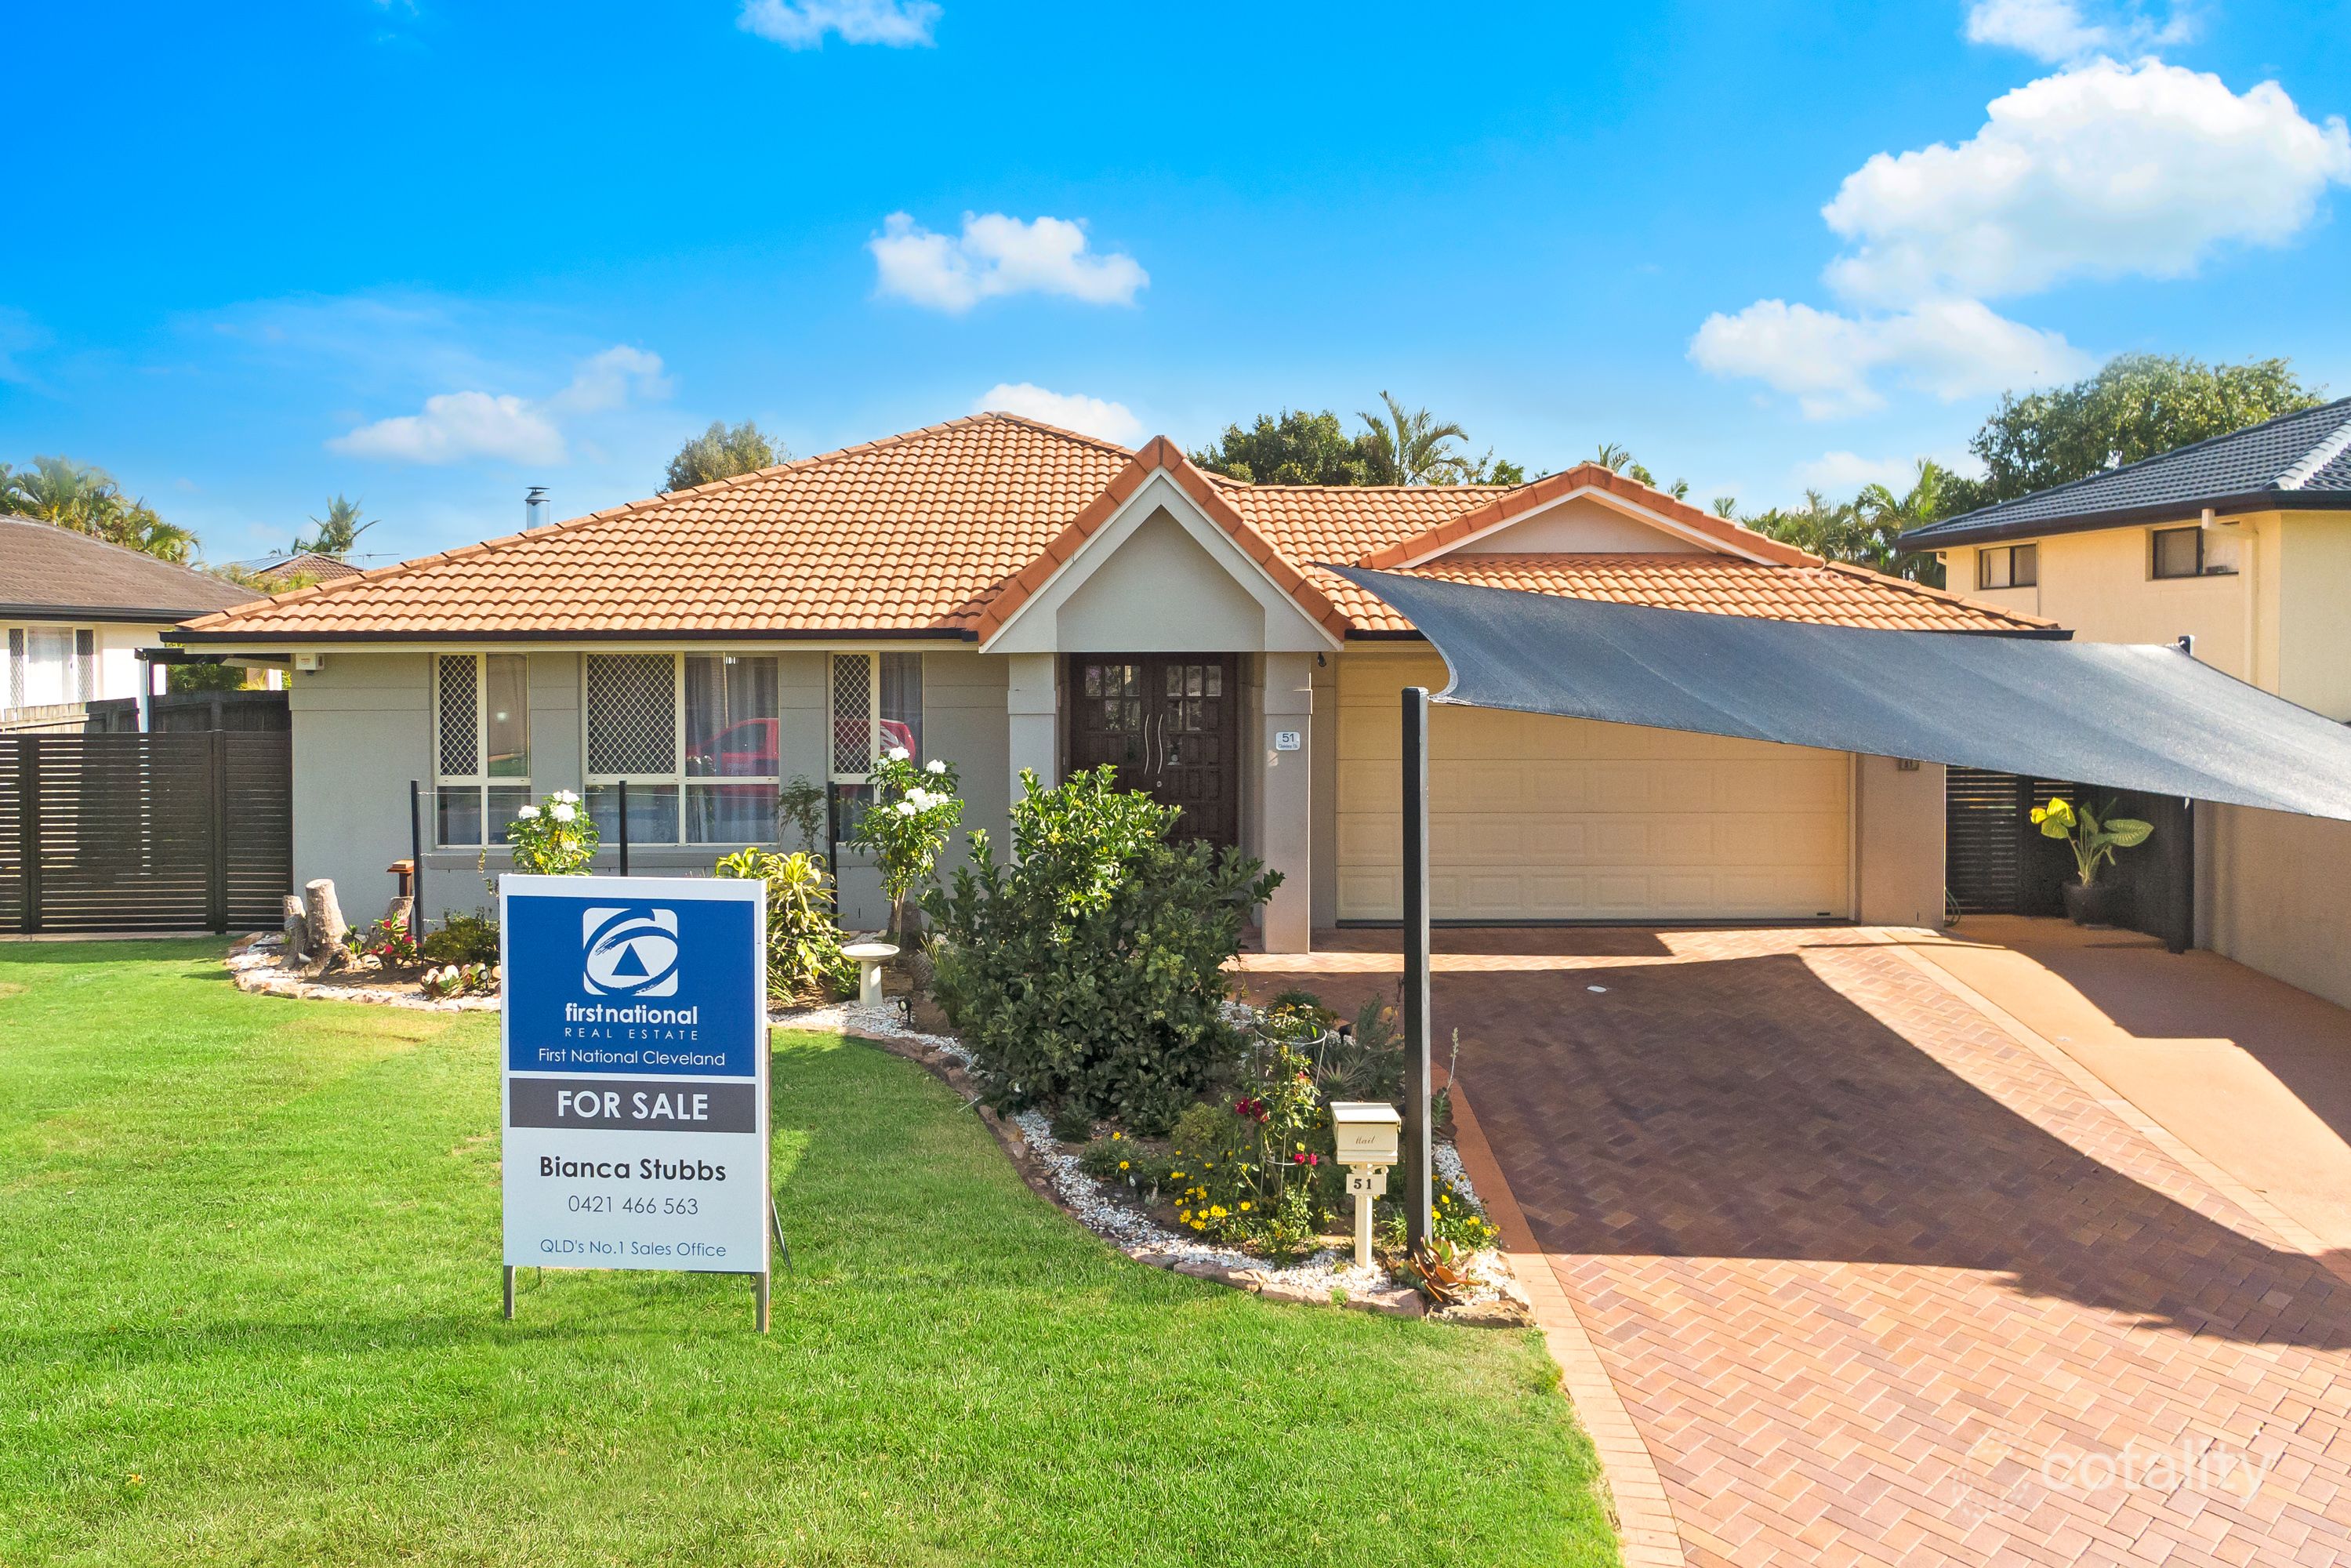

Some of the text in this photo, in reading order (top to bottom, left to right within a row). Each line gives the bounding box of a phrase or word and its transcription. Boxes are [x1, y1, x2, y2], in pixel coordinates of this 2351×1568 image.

[1283, 733, 1294, 742] 51
[565, 1028, 697, 1040] REAL ESTATE
[539, 1048, 724, 1065] First National Cleveland
[558, 1091, 707, 1120] FOR SALE
[541, 1156, 726, 1181] Bianca Stubbs
[1353, 1178, 1372, 1189] 51
[569, 1196, 698, 1214] 0421 466 563
[541, 1240, 726, 1256] QLD's No.1 Sales Office
